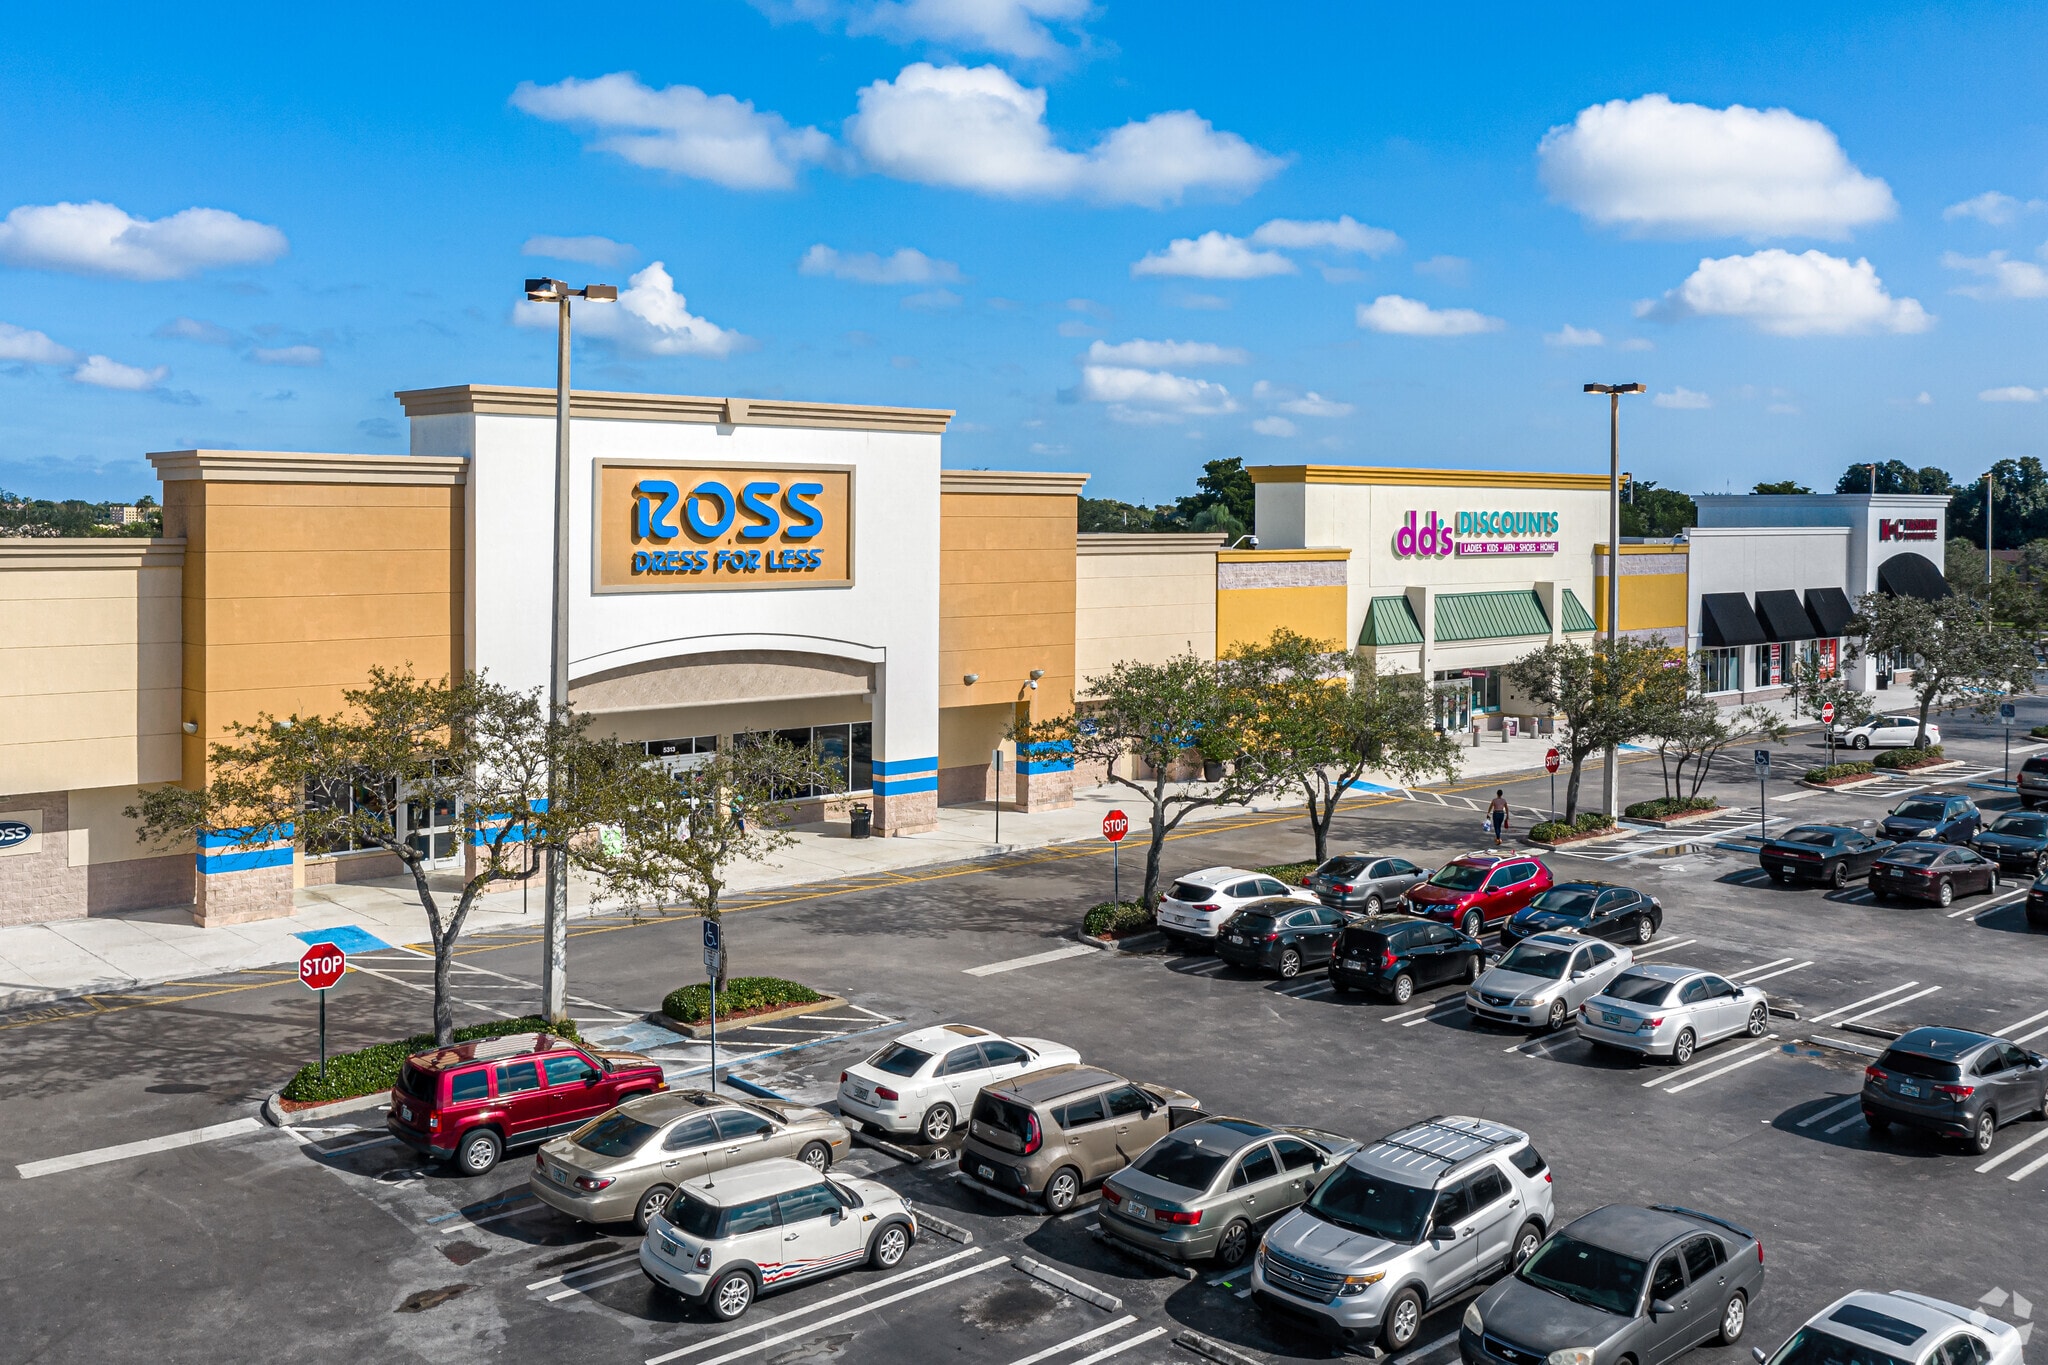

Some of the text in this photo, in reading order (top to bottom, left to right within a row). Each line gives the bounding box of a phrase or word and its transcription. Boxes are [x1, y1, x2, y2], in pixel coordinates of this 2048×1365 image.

[637, 480, 824, 538] ROSS
[1397, 510, 1559, 556] dd's DISCOUNTS
[1464, 542, 1556, 552] LADIES KIDS MEN SHOES HOME
[635, 549, 823, 572] DRESS FOR LESS
[1104, 819, 1127, 833] STOP
[302, 955, 343, 977] STOP
